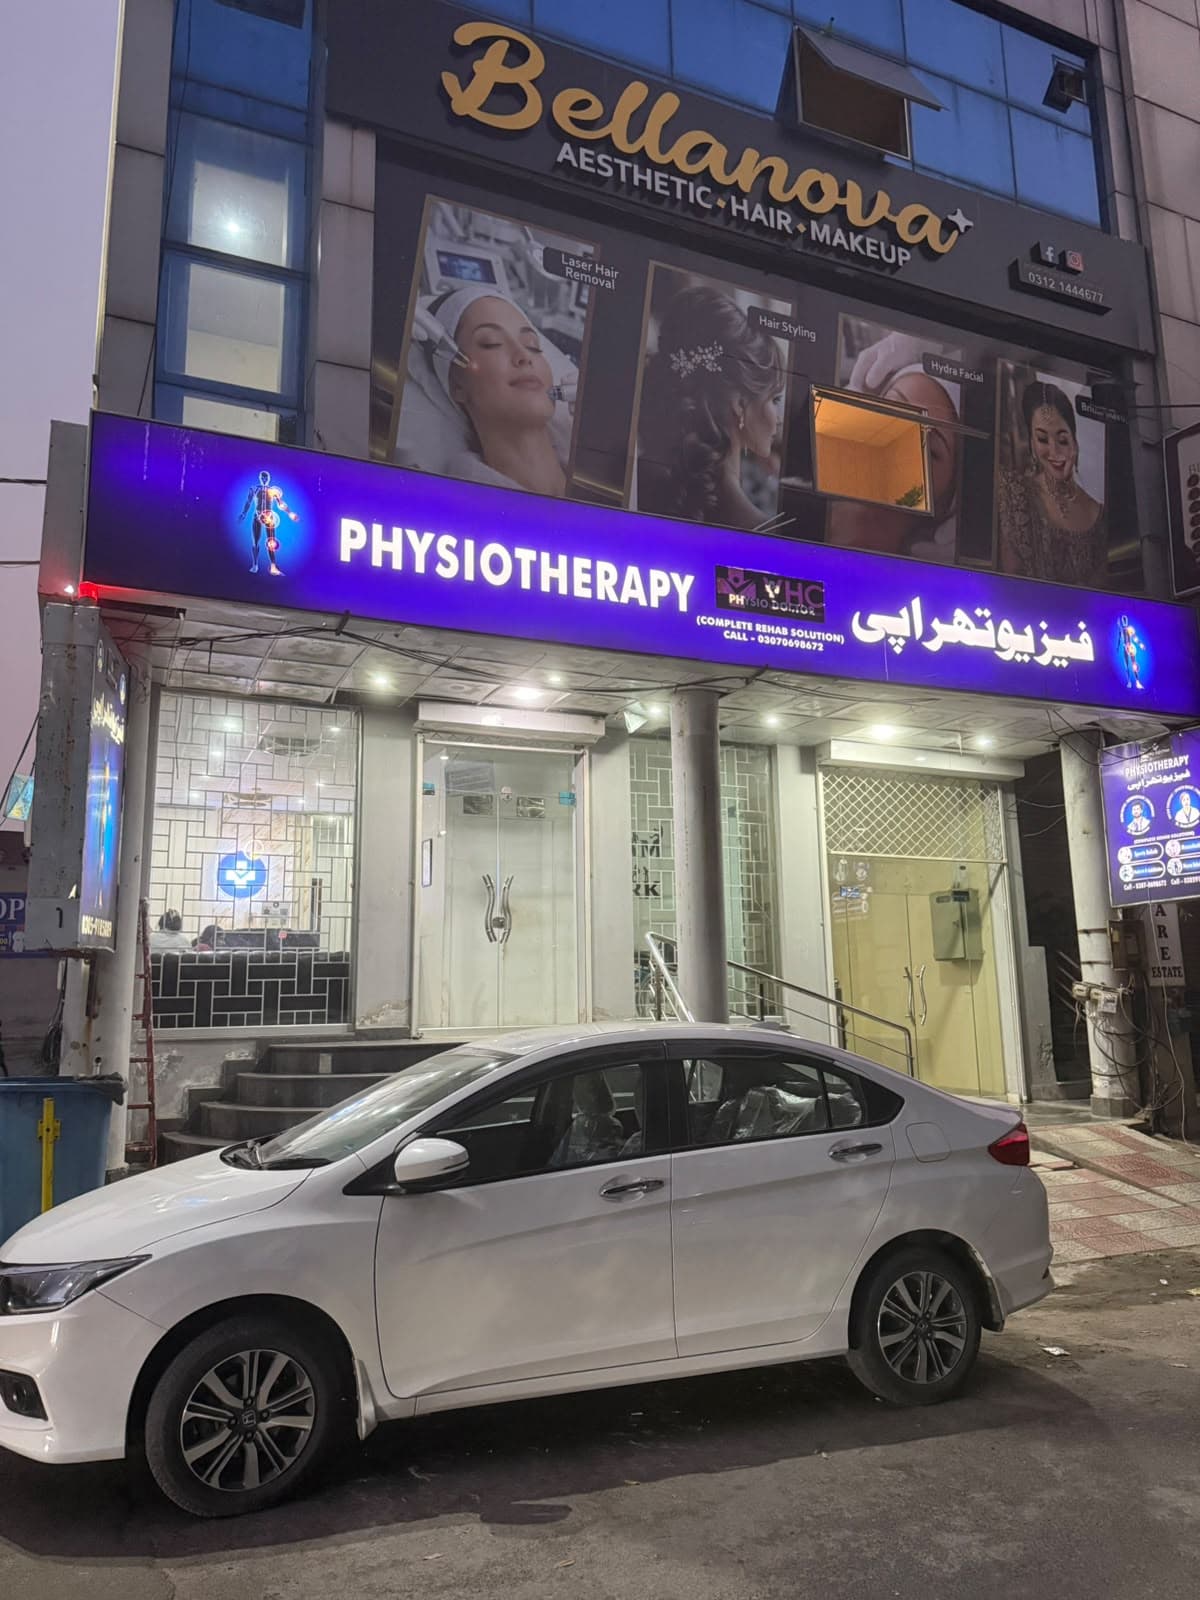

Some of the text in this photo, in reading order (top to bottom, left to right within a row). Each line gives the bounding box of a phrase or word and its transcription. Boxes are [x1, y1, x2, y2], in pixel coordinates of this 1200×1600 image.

[441, 22, 959, 254] Bellanova
[556, 142, 912, 267] AESTHETIC HAIR MAKEUP
[561, 253, 619, 279] Laser Hair
[565, 267, 616, 290] Removal
[1028, 271, 1104, 303] 0312 1444677
[758, 315, 817, 342] Hair Styling
[930, 360, 984, 383] Hydra Facial
[339, 517, 695, 613] PHYSIOTHERAPY
[696, 615, 845, 645] (COMPLETE REHAB SOLUTION)
[723, 630, 748, 642] CALL
[757, 635, 824, 651] 03070698672
[1125, 754, 1189, 778] PHYSIOTHERAPY
[1152, 966, 1184, 978] ESTATE
